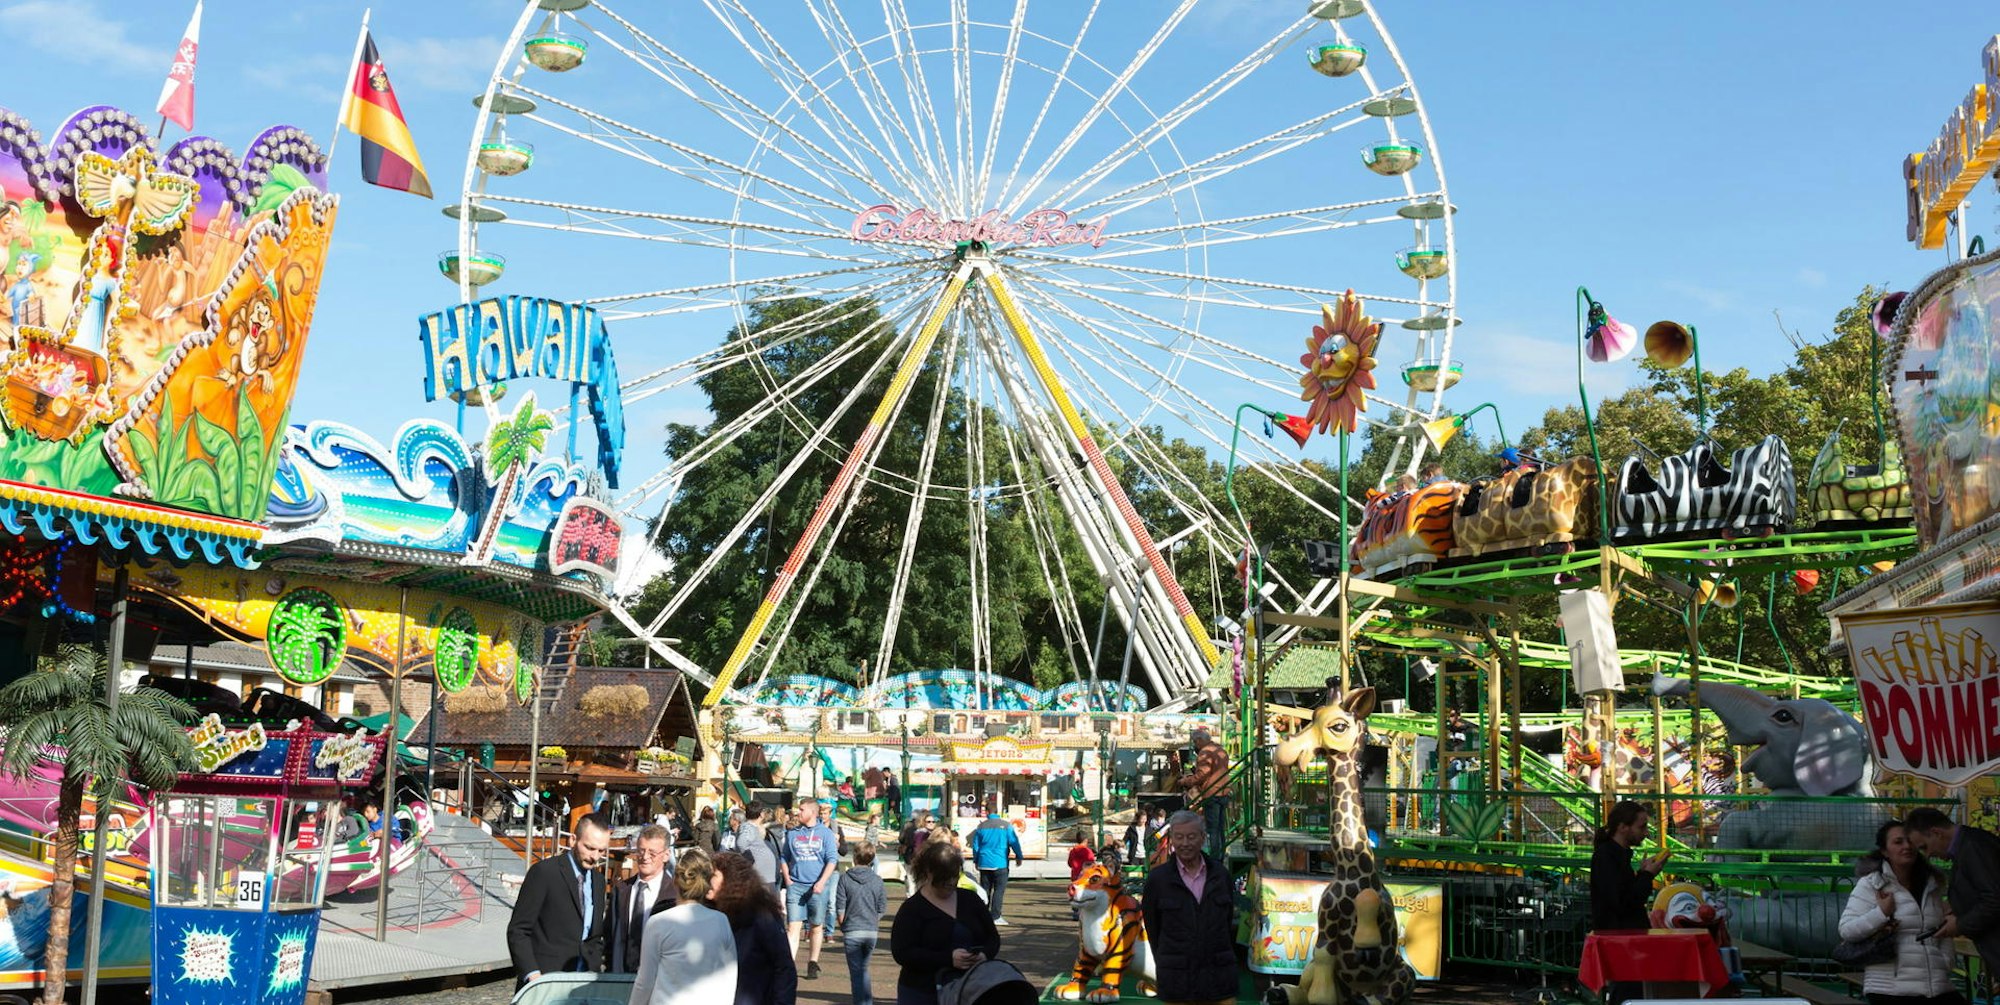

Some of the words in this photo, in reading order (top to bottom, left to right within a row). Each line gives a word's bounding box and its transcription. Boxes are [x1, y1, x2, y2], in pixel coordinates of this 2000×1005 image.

[850, 204, 1028, 243] Columbia
[1025, 208, 1113, 249] Rad
[1860, 674, 2000, 770] POMME
[195, 728, 262, 768] Swing
[240, 880, 261, 902] 36
[1260, 896, 1313, 915] ummel
